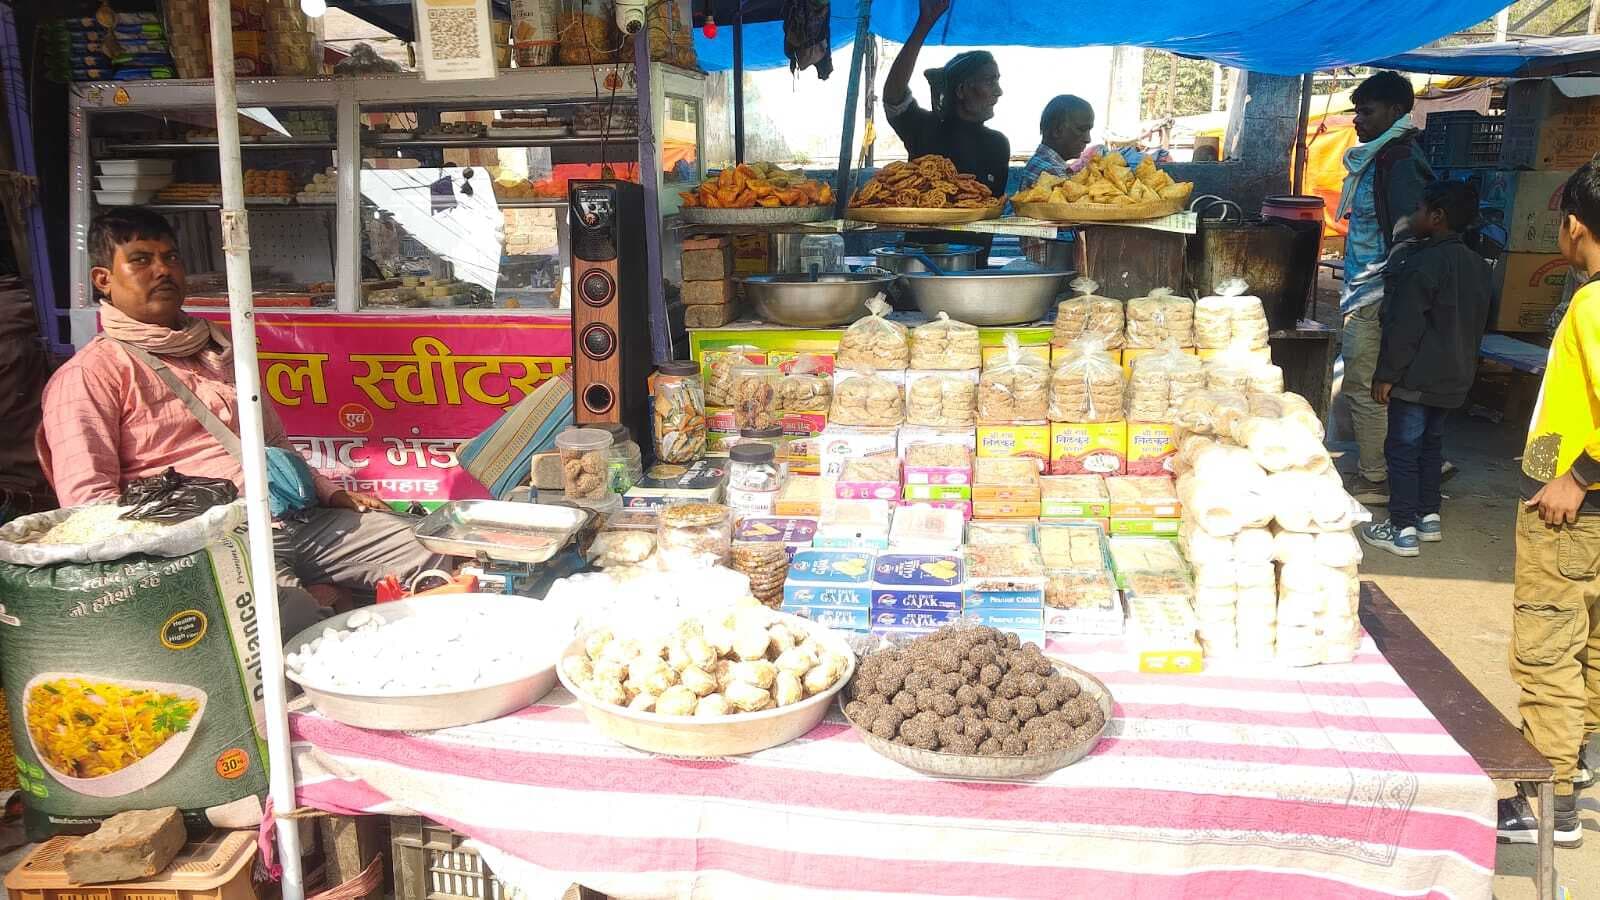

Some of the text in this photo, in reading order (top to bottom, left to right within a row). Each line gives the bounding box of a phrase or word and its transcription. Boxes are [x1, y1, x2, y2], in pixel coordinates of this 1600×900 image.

[345, 411, 367, 428] एवं
[902, 597, 939, 609] GAJAK
[222, 759, 237, 771] 30
